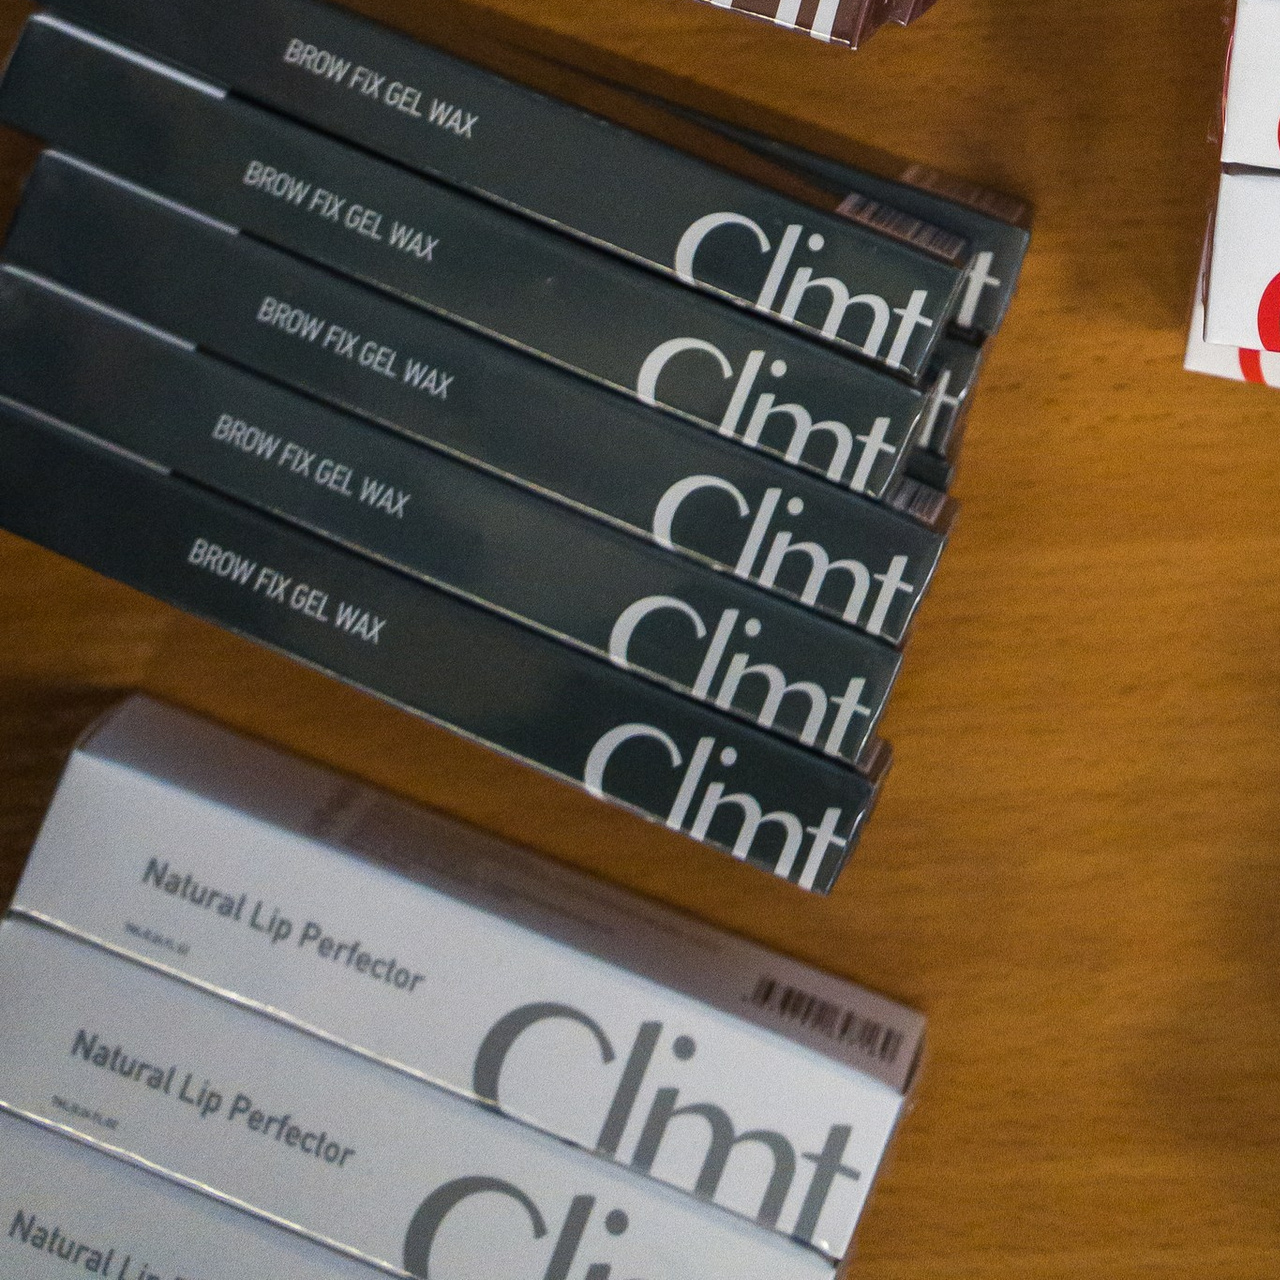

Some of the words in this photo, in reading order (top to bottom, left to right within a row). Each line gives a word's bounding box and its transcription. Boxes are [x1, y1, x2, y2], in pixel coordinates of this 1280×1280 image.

[283, 38, 352, 83] BROW
[350, 65, 387, 100] FIX
[384, 81, 422, 117] GEL
[427, 97, 479, 139] WAX
[243, 160, 311, 207] BROW
[308, 188, 346, 223] FIX
[343, 204, 383, 242] GEL
[388, 220, 440, 263] WAX
[256, 296, 327, 341] BROW
[322, 324, 361, 360] FIX
[358, 340, 397, 379] GEL
[402, 357, 455, 400] WAX
[675, 212, 934, 369] Climt
[211, 414, 282, 461] BROW
[278, 441, 317, 477] FIX
[314, 458, 353, 497] GEL
[359, 476, 412, 520] WAX
[637, 338, 897, 493] Climt
[187, 537, 257, 585] BROW
[253, 564, 292, 601] FIX
[289, 582, 328, 623] GEL
[334, 600, 387, 645] WAX
[653, 475, 914, 635] Climt
[608, 595, 871, 756] Climt
[584, 722, 847, 891] Climt
[141, 856, 248, 924] Natural
[249, 900, 294, 943] Lip
[298, 921, 426, 995] Perfector
[70, 1028, 179, 1096] Natural
[178, 1073, 223, 1117] Lip
[227, 1094, 356, 1170] Perfector
[472, 1000, 861, 1244] Climt
[9, 1209, 112, 1278] Natural
